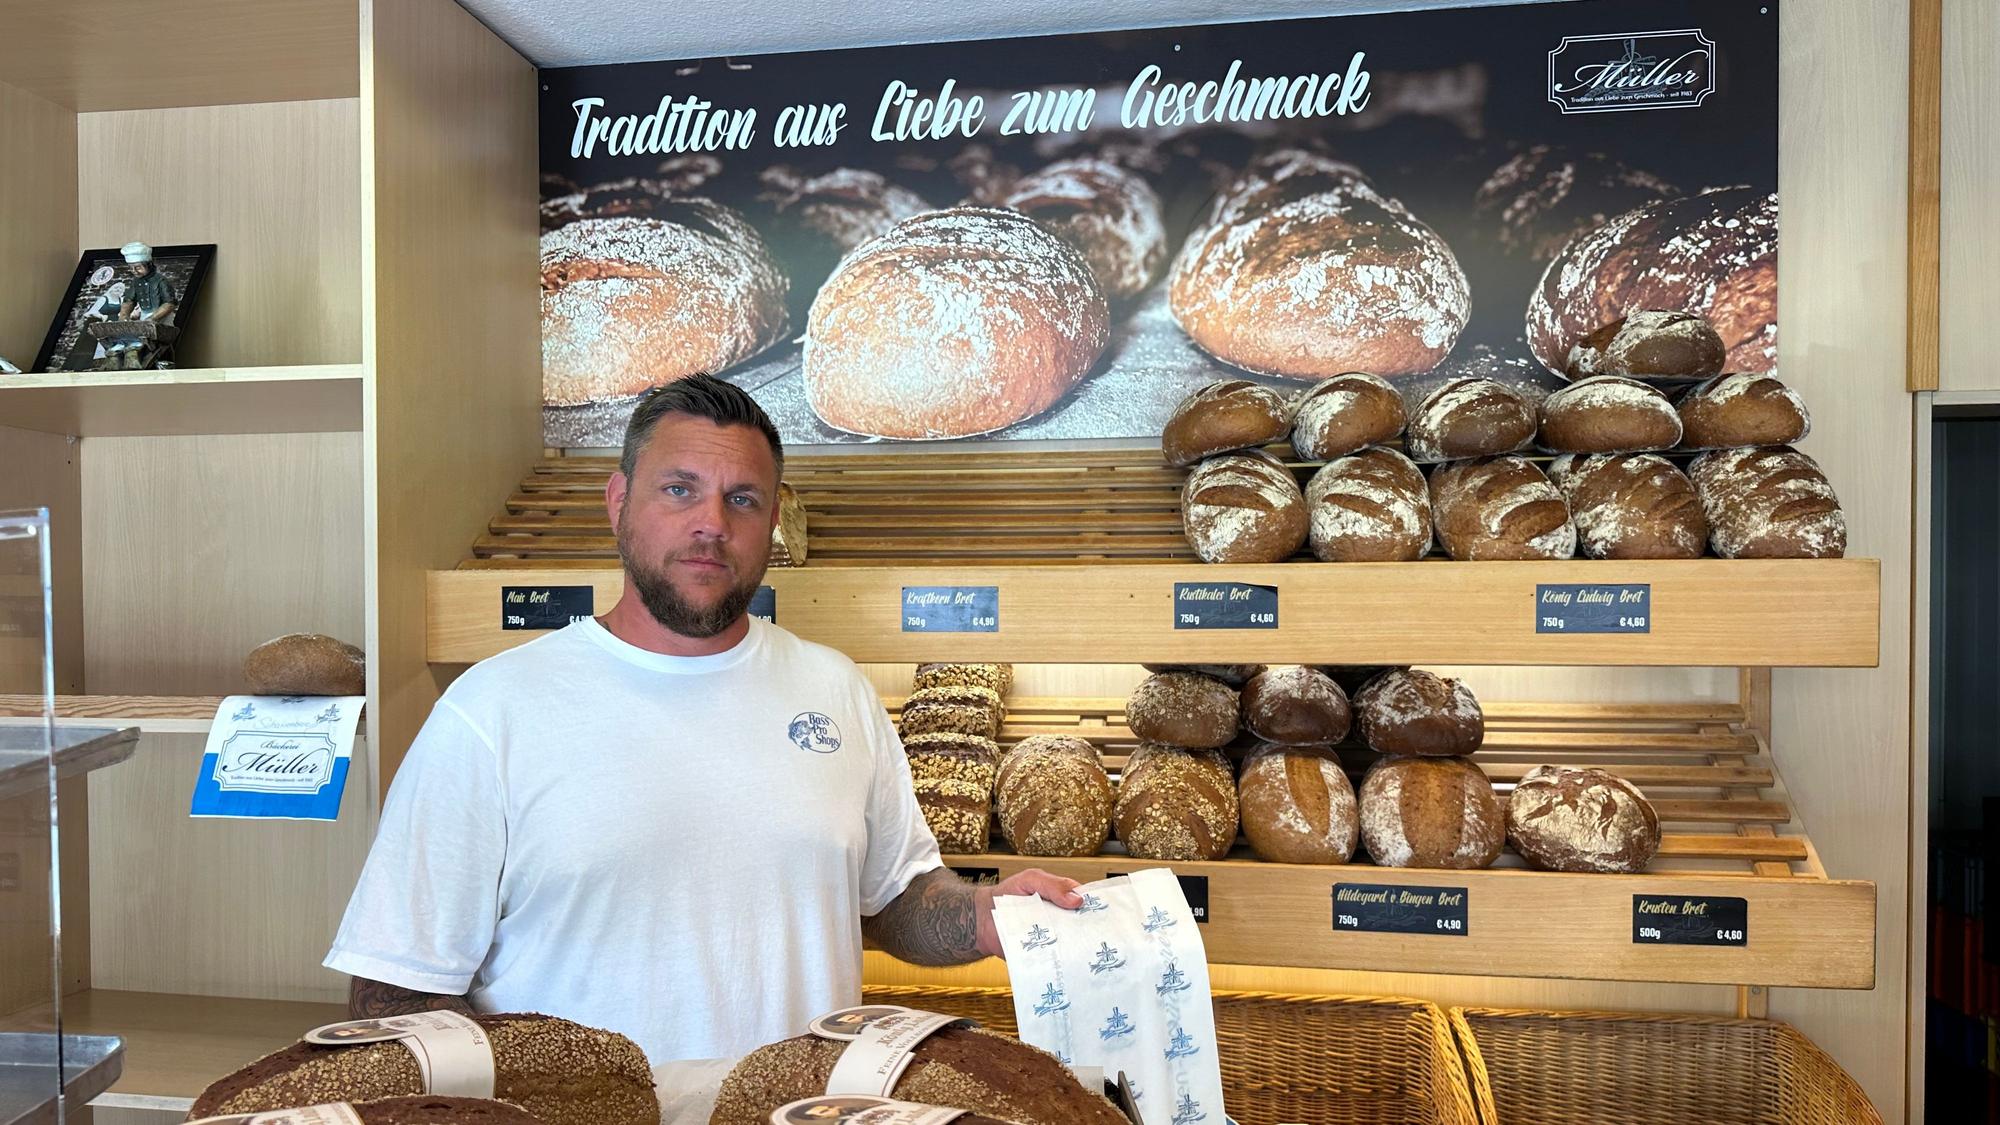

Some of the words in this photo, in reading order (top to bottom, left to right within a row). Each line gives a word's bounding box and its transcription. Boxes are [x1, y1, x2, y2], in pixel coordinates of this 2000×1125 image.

[1554, 49, 1710, 93] Müller
[570, 94, 757, 159] Tradition
[773, 101, 848, 149] aus
[870, 78, 987, 143] Liebe
[1000, 87, 1097, 136] zum
[1120, 51, 1371, 130] Geschmack
[506, 591, 526, 603] Mais
[529, 591, 550, 604] Brot
[954, 591, 976, 605] Brot
[1180, 587, 1225, 601] Rustikales
[1229, 587, 1253, 601] Brot
[1576, 589, 1615, 606] Ludwig
[1619, 589, 1645, 603] Brot
[808, 713, 830, 726] Bass
[809, 724, 827, 735] Pro
[816, 734, 839, 748] Shops
[222, 748, 330, 774] Müller
[1337, 888, 1388, 905] Hildegard
[1400, 890, 1433, 907] Bingen
[1438, 892, 1462, 906] Brot
[1638, 900, 1677, 914] Krusten
[1682, 901, 1708, 915] Brot
